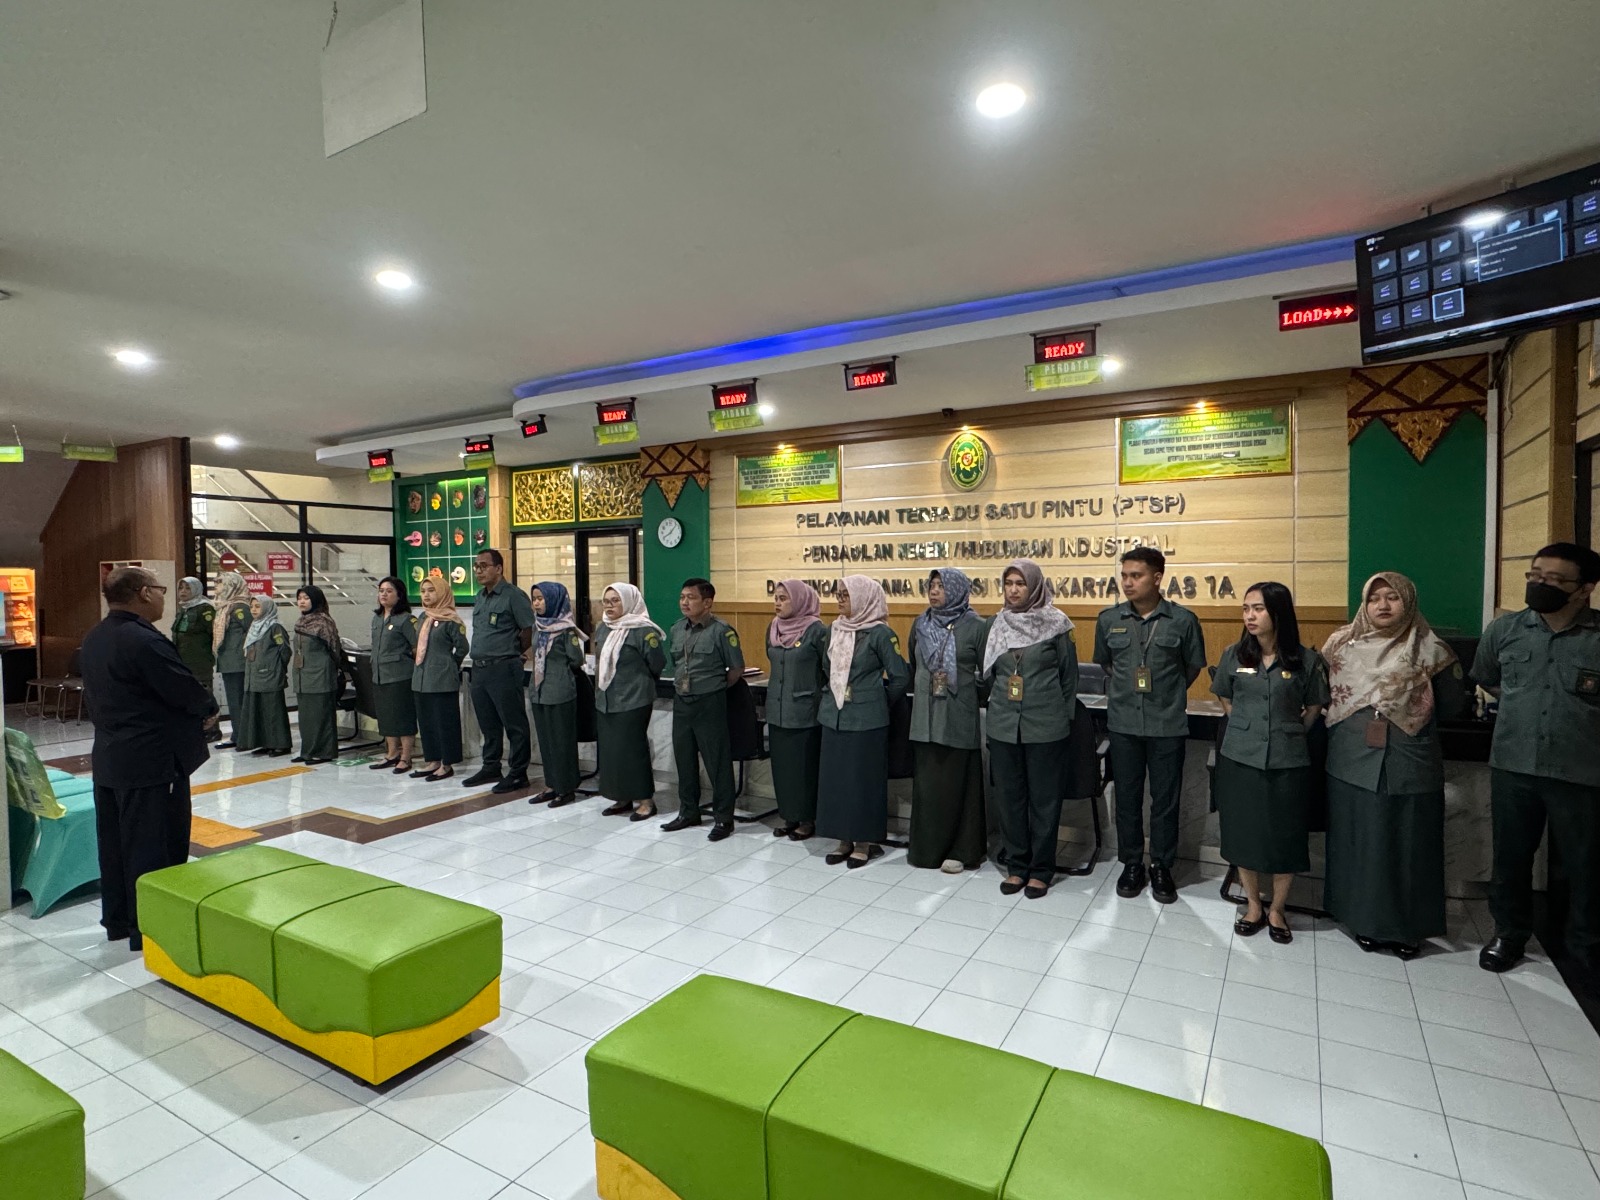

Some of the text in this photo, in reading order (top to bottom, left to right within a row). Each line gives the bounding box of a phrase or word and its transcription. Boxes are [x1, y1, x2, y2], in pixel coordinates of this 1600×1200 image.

[1283, 307, 1323, 325] LOAD
[1044, 341, 1084, 358] READY
[1044, 359, 1089, 375] PERDATA
[853, 372, 886, 387] READY
[719, 392, 747, 406] READY
[603, 410, 627, 422] READY
[796, 492, 1187, 529] PELAYANAN TERPADU SATU PINTU (PTSP)
[803, 542, 894, 563] PENGADILAN
[898, 540, 950, 561] NEGERI
[1204, 575, 1237, 600] 1A
